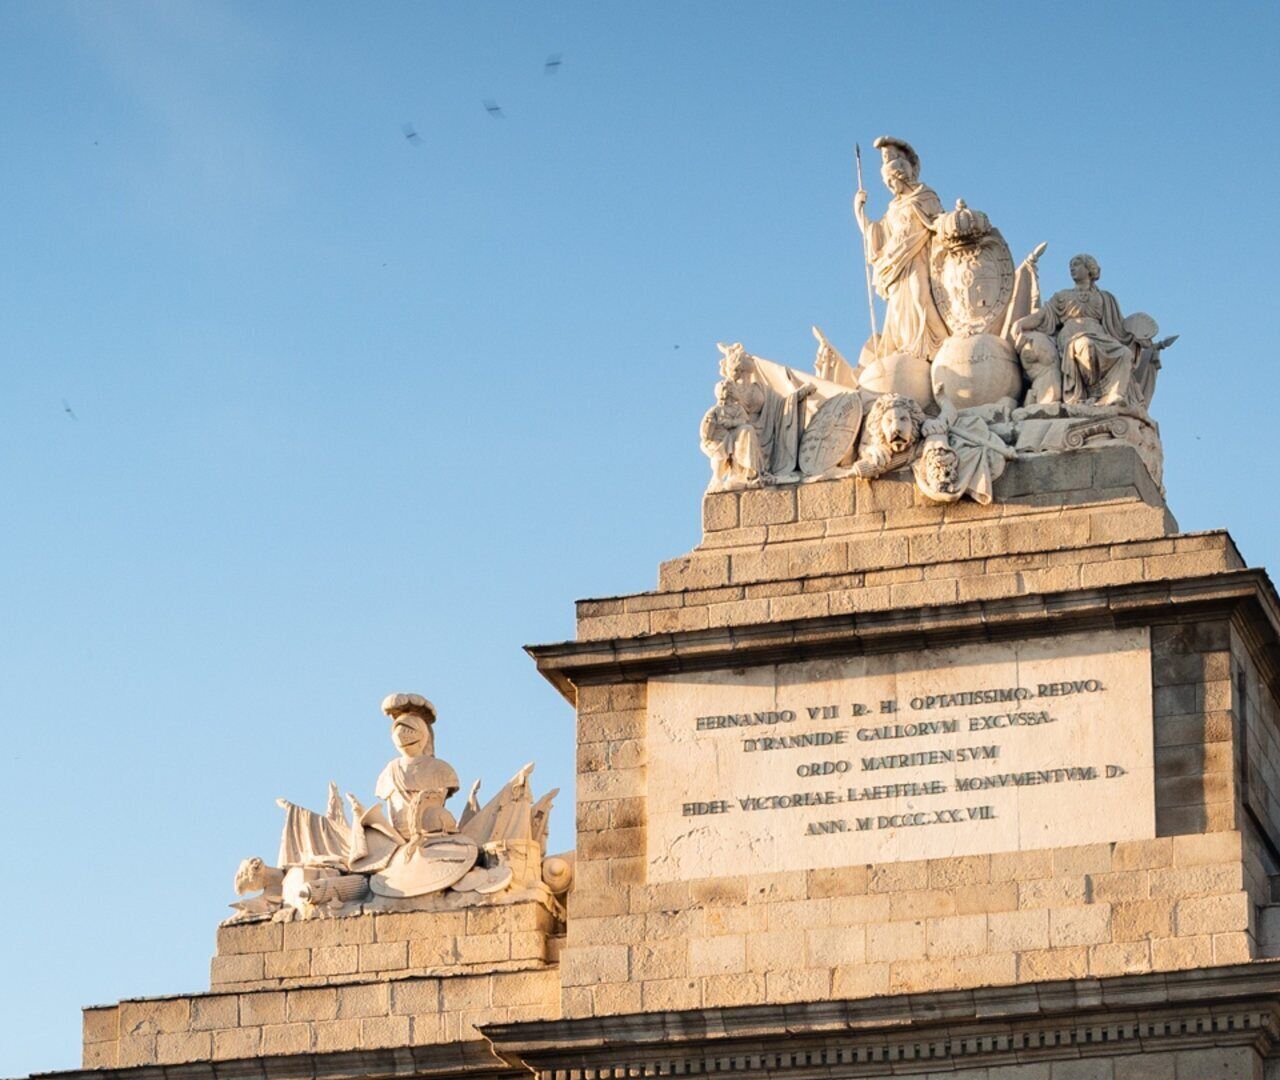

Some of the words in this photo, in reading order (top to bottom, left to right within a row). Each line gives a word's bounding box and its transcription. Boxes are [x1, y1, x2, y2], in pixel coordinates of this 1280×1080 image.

[696, 709, 797, 731] FERNANDO
[806, 705, 840, 721] VII
[856, 719, 960, 742] GALLORVM
[796, 760, 852, 778] ORDO
[861, 745, 1001, 772] MATRITENSVM
